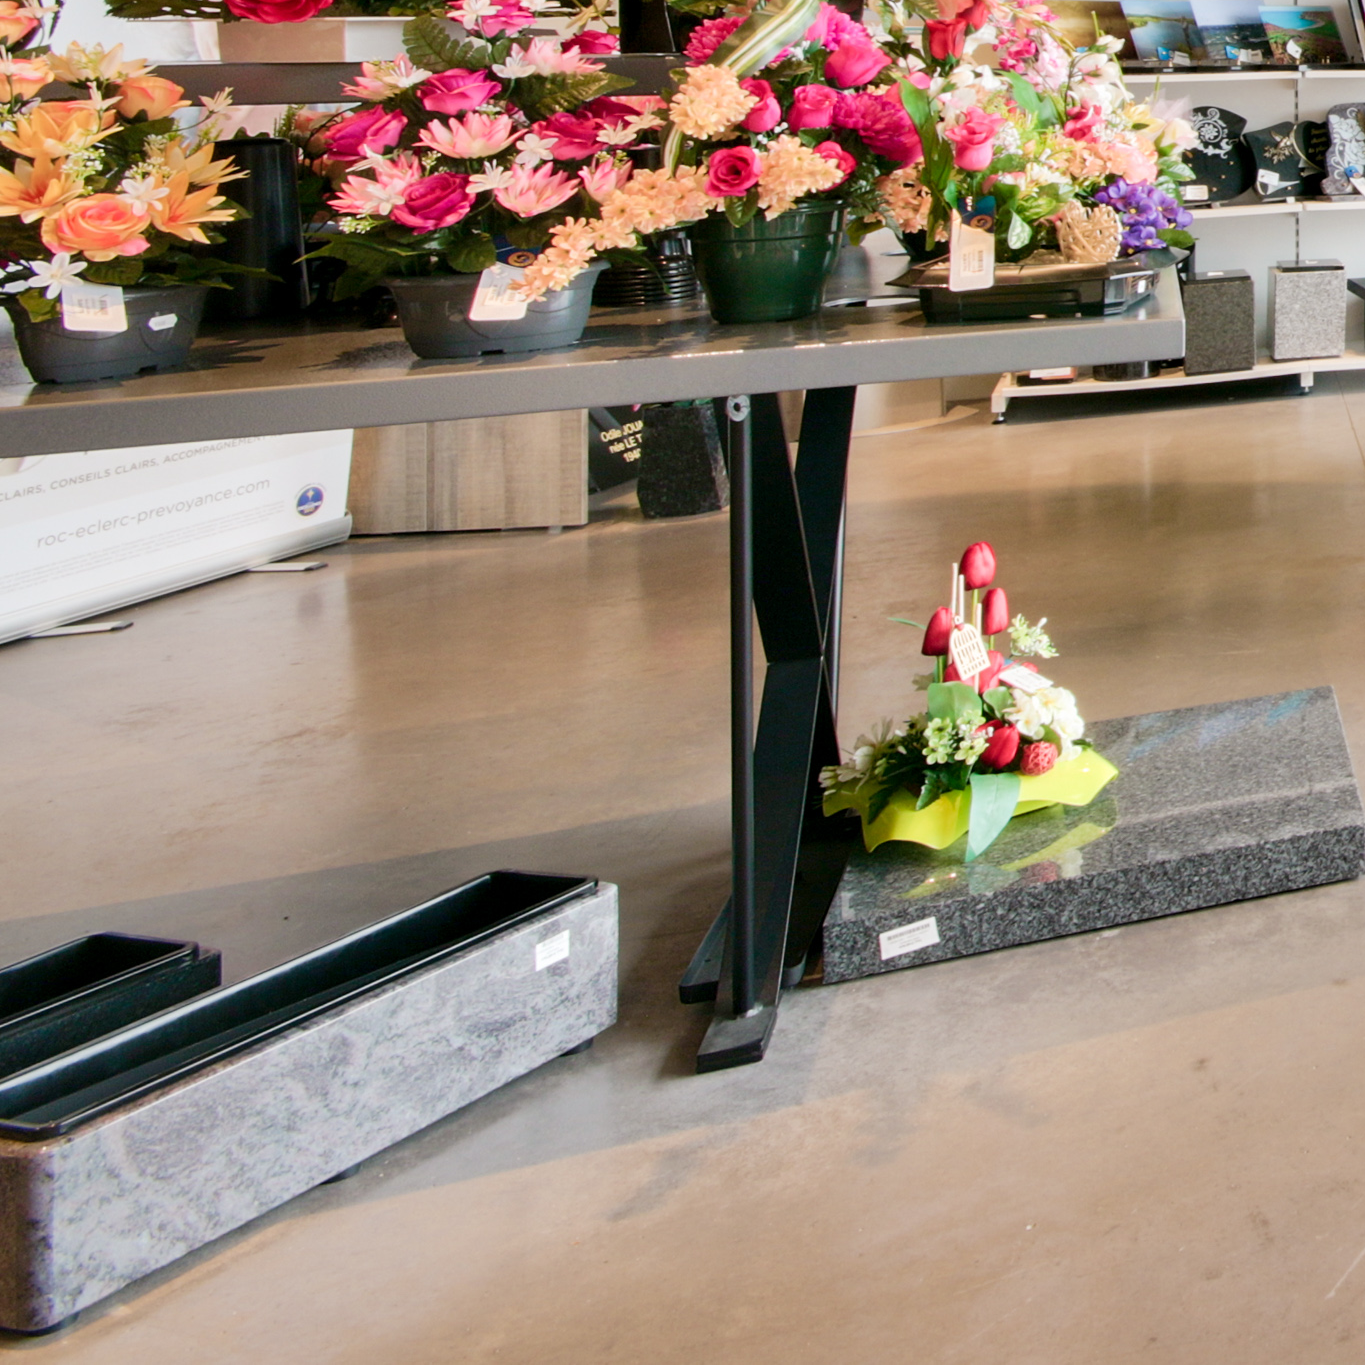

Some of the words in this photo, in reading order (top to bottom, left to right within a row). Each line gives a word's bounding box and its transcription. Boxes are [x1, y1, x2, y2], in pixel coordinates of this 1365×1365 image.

[624, 436, 637, 449] LE
[50, 468, 111, 490] CONSEILS
[114, 458, 160, 476] CLAIRS,
[37, 477, 271, 549] roc-eclerc-prevoyance.com
